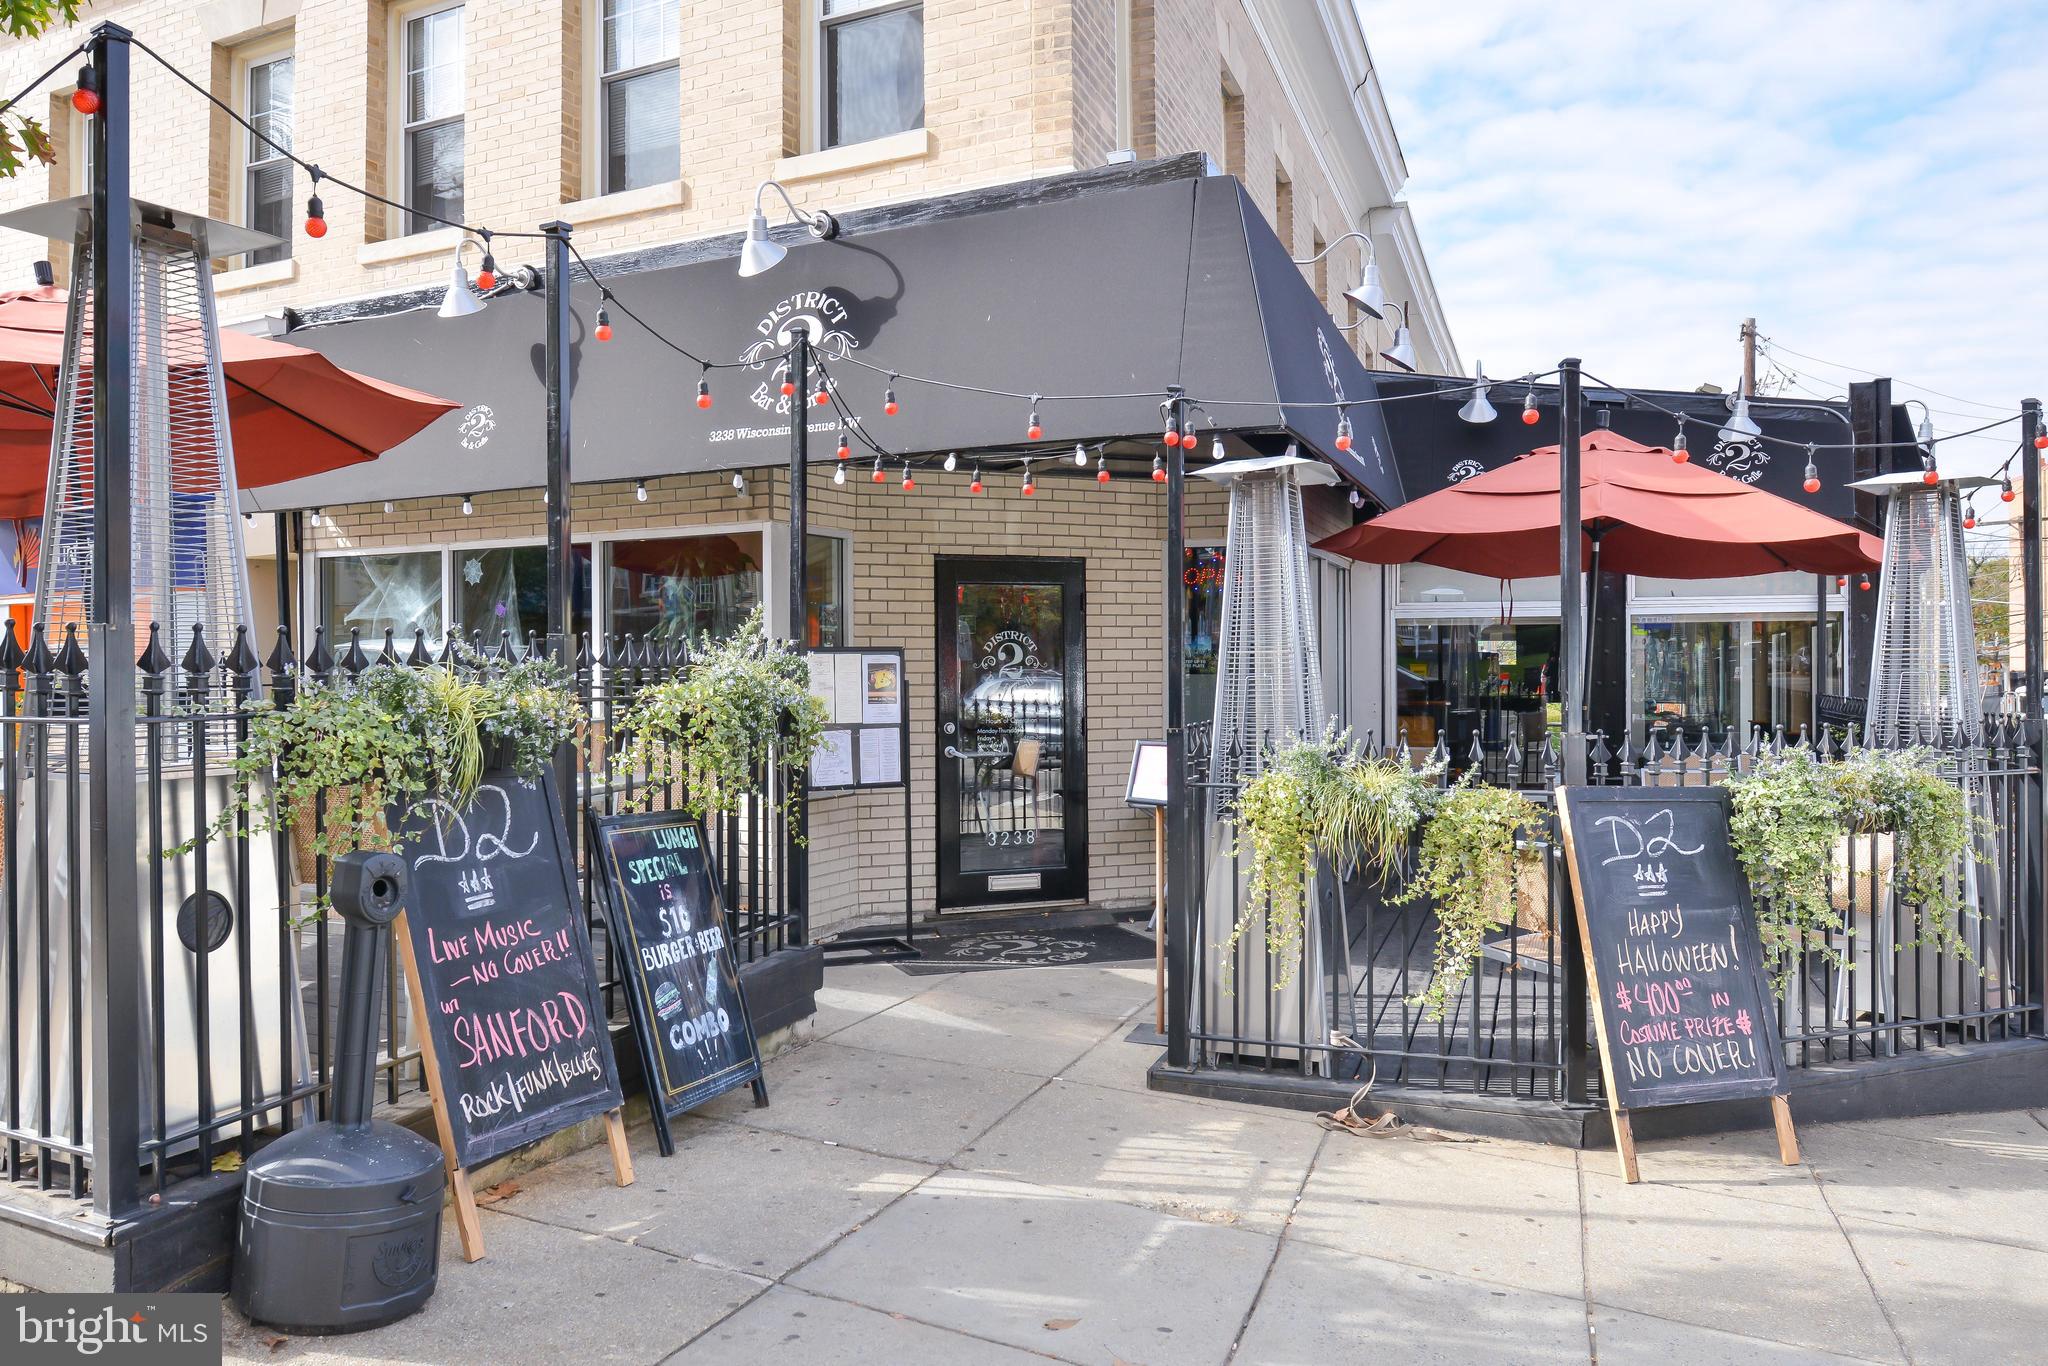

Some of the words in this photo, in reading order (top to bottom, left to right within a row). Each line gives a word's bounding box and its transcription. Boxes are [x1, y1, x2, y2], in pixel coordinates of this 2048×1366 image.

[757, 291, 848, 336] DISTRICT
[750, 381, 774, 410] Bar
[776, 394, 791, 414] &
[468, 413, 486, 437] 2
[708, 430, 735, 442] 3238
[736, 424, 791, 440] Wisconsin
[806, 420, 836, 433] enue
[1452, 459, 1484, 472] DISTRICT
[1725, 443, 1751, 471] 2
[983, 630, 1038, 653] DISTRICT
[997, 642, 1024, 679] 2
[406, 784, 539, 871] D2
[653, 826, 699, 849] LUNCH
[988, 830, 1035, 846] 3238
[1594, 808, 1704, 867] D2
[628, 852, 689, 884] SPECIAL
[1628, 903, 1684, 939] HAPPY
[427, 927, 469, 964] LIVE
[474, 919, 542, 955] MUSIC
[641, 935, 697, 972] BURGER
[697, 926, 725, 955] BEER
[1711, 991, 1730, 1009] IN
[453, 991, 587, 1068] SANFORD
[669, 1007, 730, 1051] COMBO
[1625, 1046, 1663, 1083] NO
[1673, 1037, 1756, 1076] COVER!
